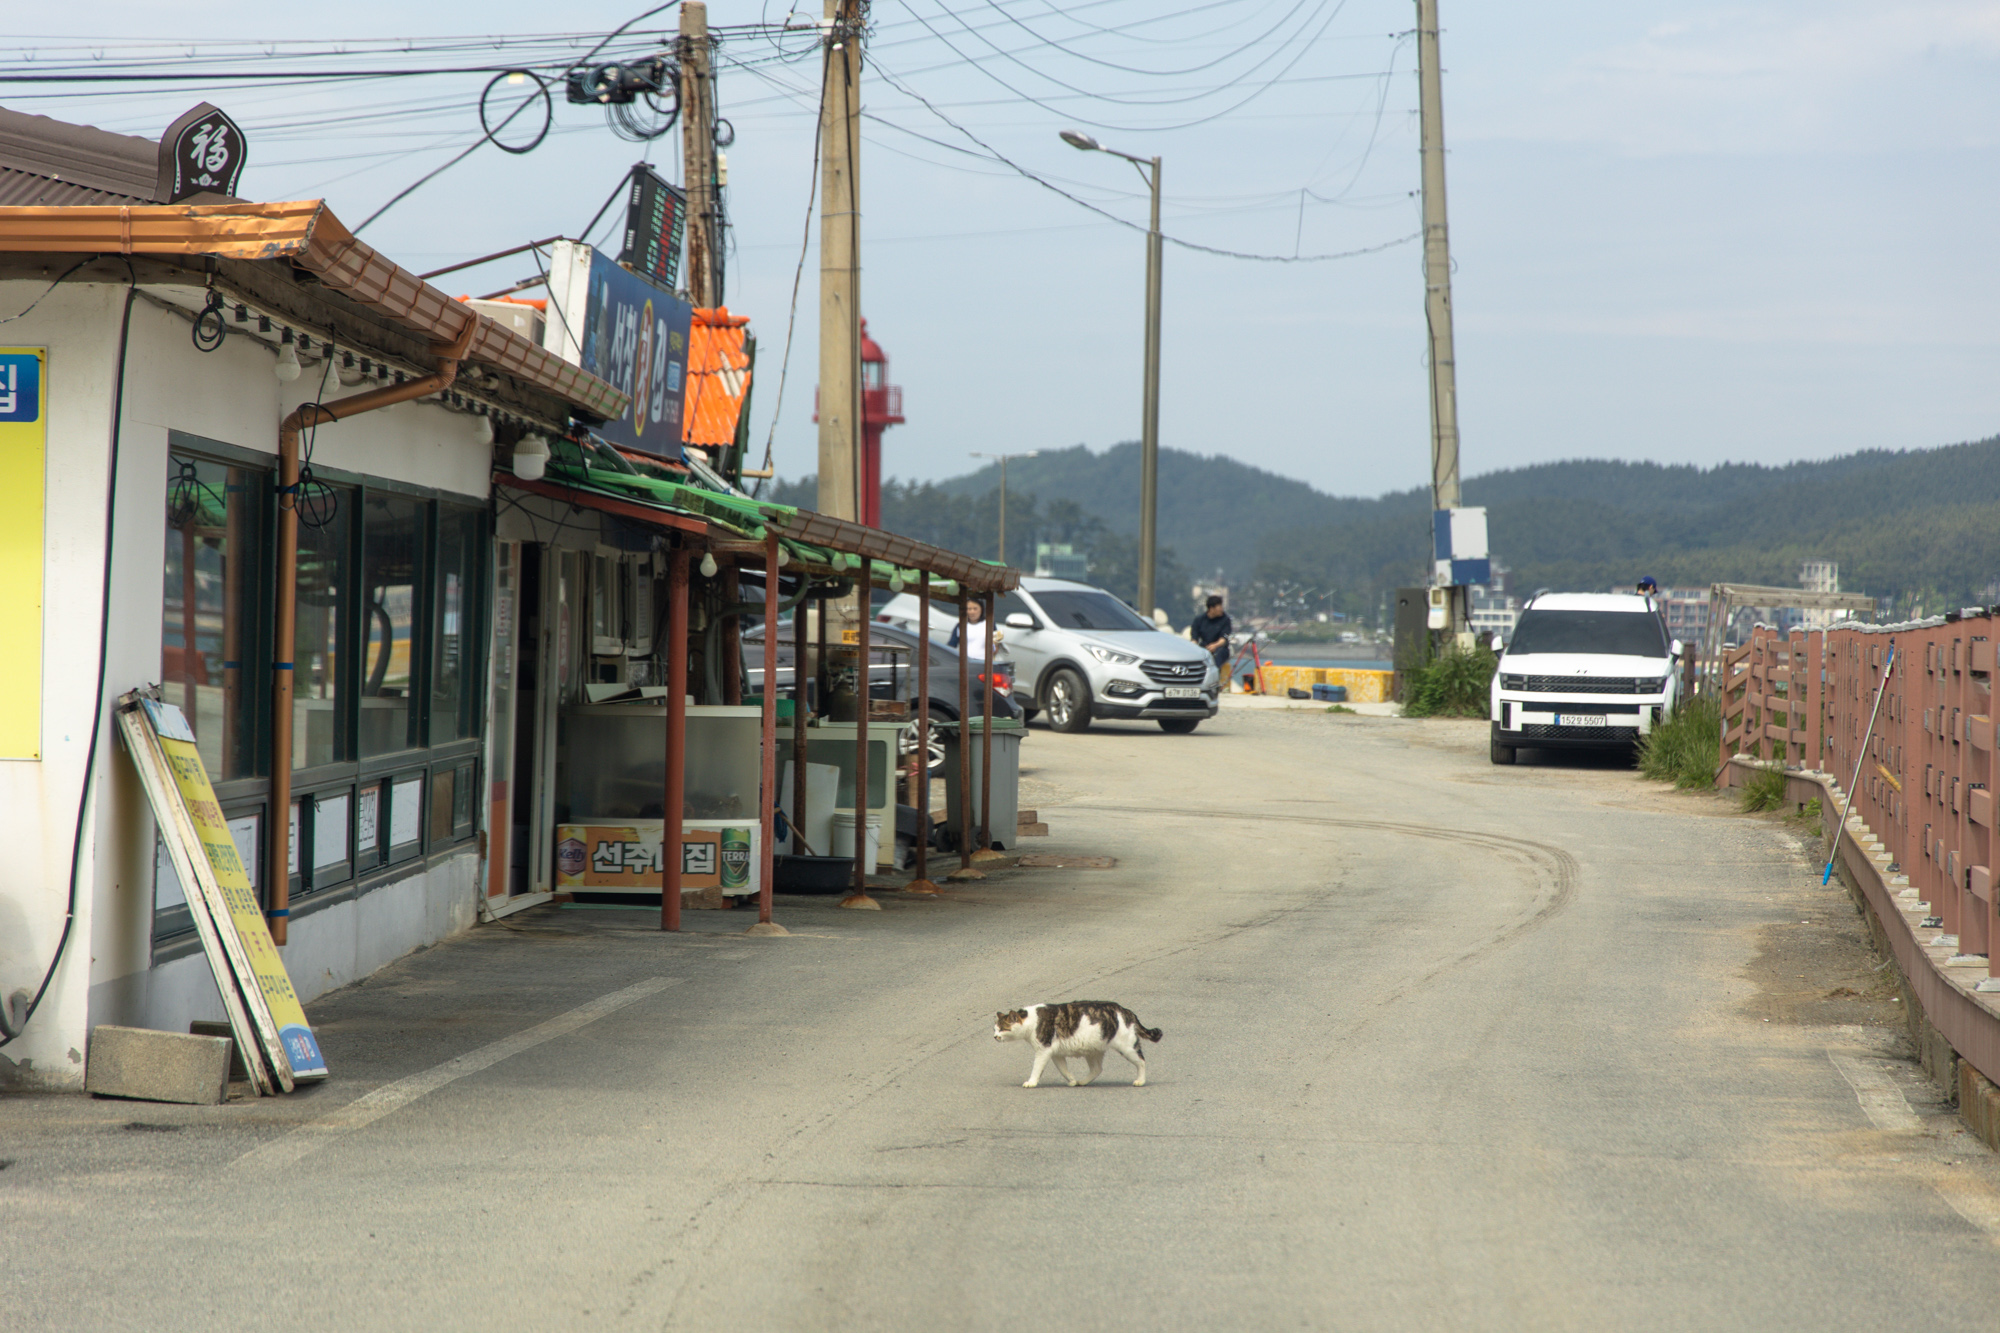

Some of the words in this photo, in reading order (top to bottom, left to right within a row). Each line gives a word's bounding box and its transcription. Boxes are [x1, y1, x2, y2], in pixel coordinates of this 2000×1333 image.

[190, 124, 229, 173] 福
[1584, 716, 1604, 726] 5507
[592, 841, 717, 875] 선주집
